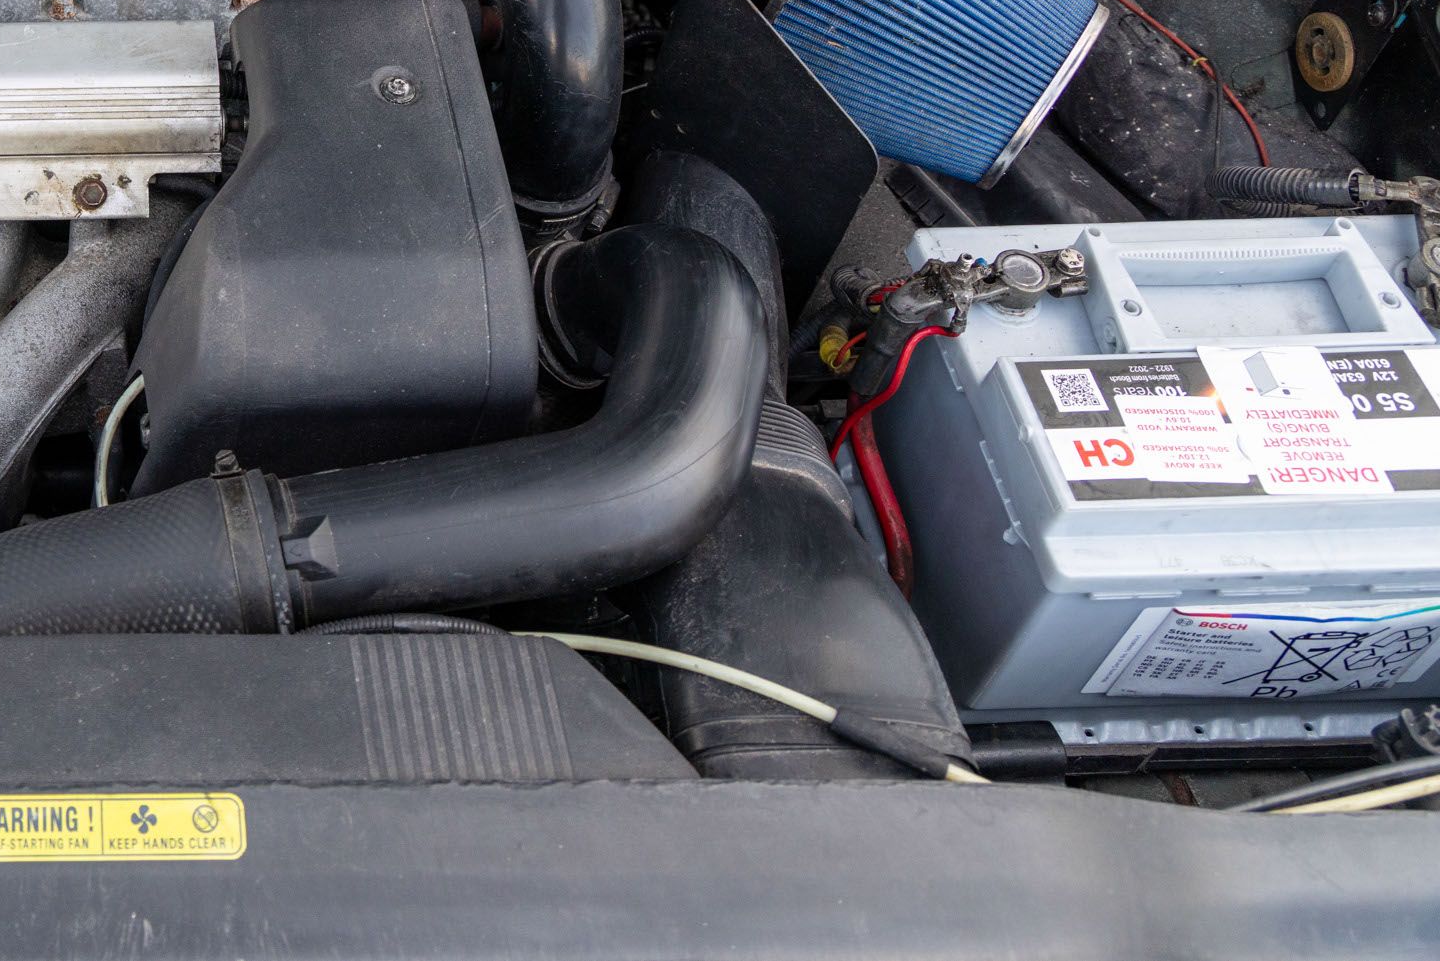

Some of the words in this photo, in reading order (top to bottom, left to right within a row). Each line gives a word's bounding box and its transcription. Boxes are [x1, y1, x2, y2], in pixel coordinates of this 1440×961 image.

[1128, 365, 1148, 373] 2022
[1154, 364, 1175, 372] 1922
[1353, 358, 1391, 369] 610A
[1109, 375, 1131, 383] Bosch
[1148, 374, 1180, 382] Batteries
[1373, 371, 1399, 382] 12V
[1113, 387, 1154, 396] Years
[1154, 385, 1187, 397] 100
[1347, 393, 1373, 413] 0
[1375, 392, 1416, 413] S5
[1124, 408, 1186, 416] DISCHARGED
[1245, 409, 1340, 420] IMMEDIATELY
[1136, 424, 1162, 432] VOID
[1268, 423, 1330, 434] BUNG(S)
[1142, 444, 1206, 452] DISCHARGED
[1263, 437, 1352, 448] TRANSPORT
[1073, 438, 1135, 468] CH
[1281, 451, 1345, 462] REMOVE
[1198, 462, 1223, 470] KEEP
[1268, 467, 1380, 483] DANGER!
[1198, 621, 1248, 630] BOSCH
[1167, 628, 1208, 638] Starter
[1158, 639, 1187, 648] Safety
[1188, 643, 1242, 652] instructions
[1163, 635, 1202, 643] leisure
[1204, 639, 1254, 647] batteries
[1154, 646, 1195, 655] warranty
[1249, 686, 1298, 699] Pb
[68, 837, 90, 850] FAN
[108, 838, 140, 850] KEEP
[143, 837, 185, 850] HANDS
[188, 837, 227, 850] CLEAR
